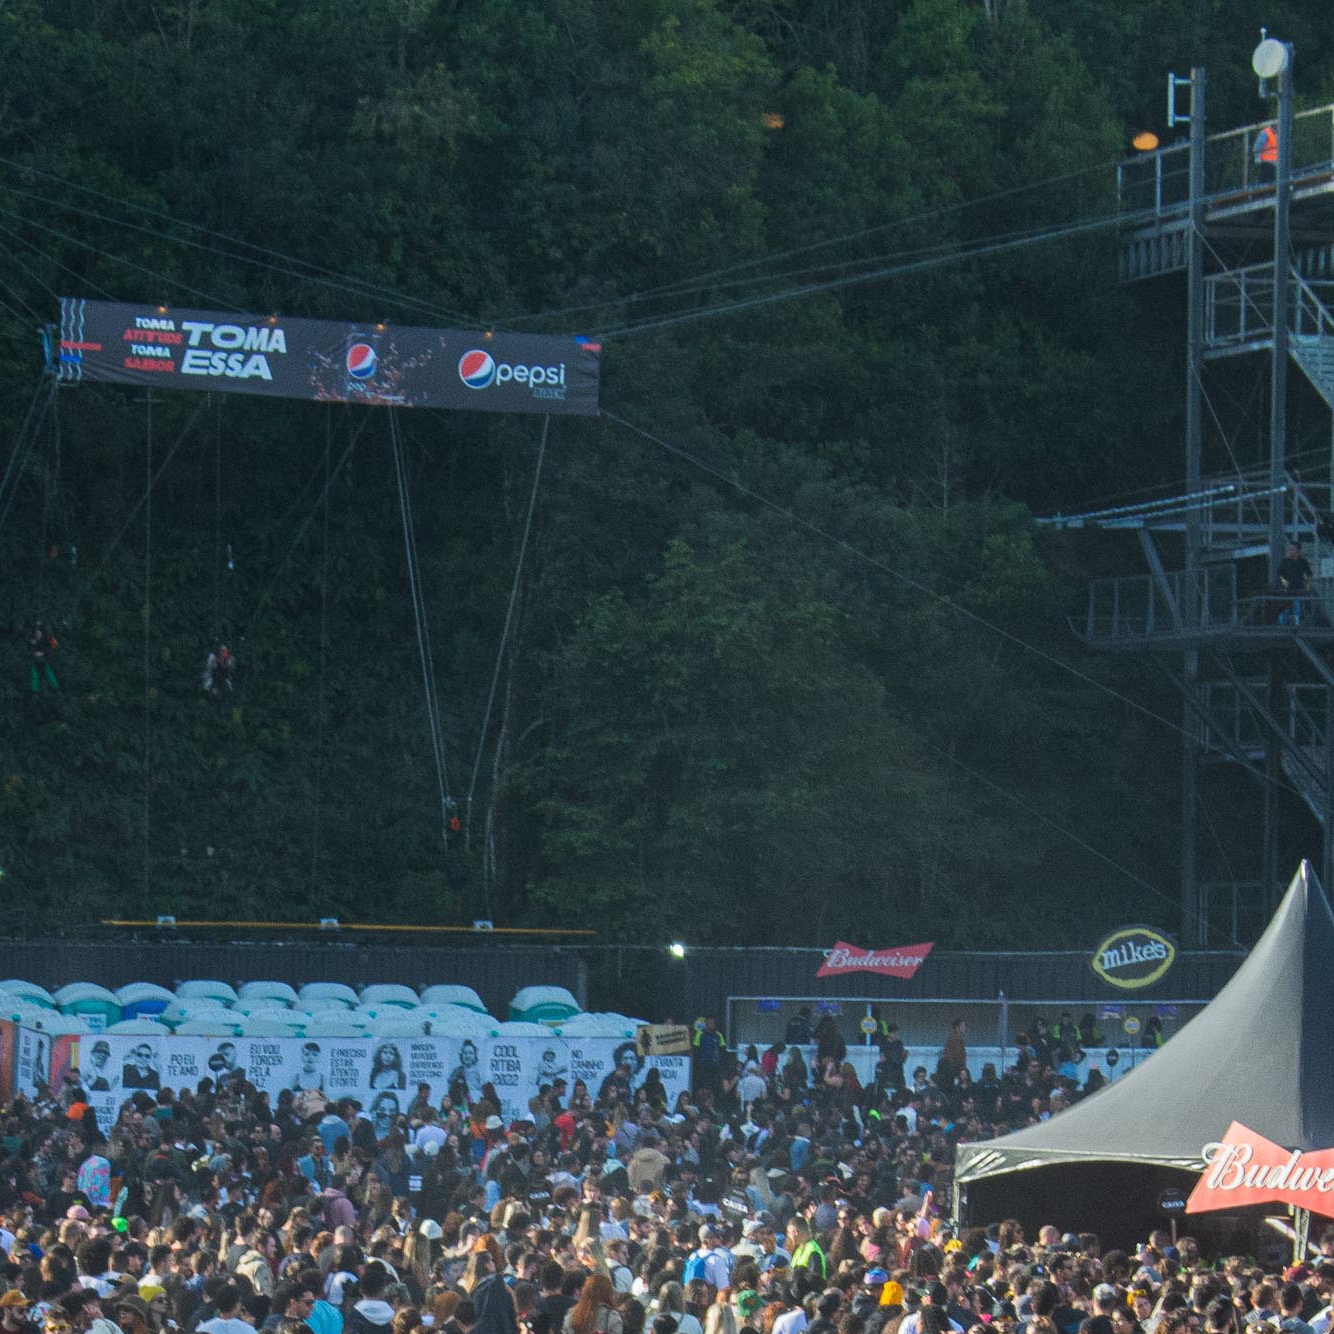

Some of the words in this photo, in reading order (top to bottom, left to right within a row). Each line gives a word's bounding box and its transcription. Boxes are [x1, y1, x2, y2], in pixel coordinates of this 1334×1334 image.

[135, 317, 175, 331] TOMA
[181, 321, 287, 353] TOMA
[131, 344, 171, 359] TOMA
[180, 348, 273, 380] ESSA
[495, 363, 566, 388] pepsi
[822, 947, 923, 969] Budweiser
[1101, 938, 1167, 970] mike's
[493, 1045, 520, 1058] COOL
[493, 1073, 520, 1086] 2022
